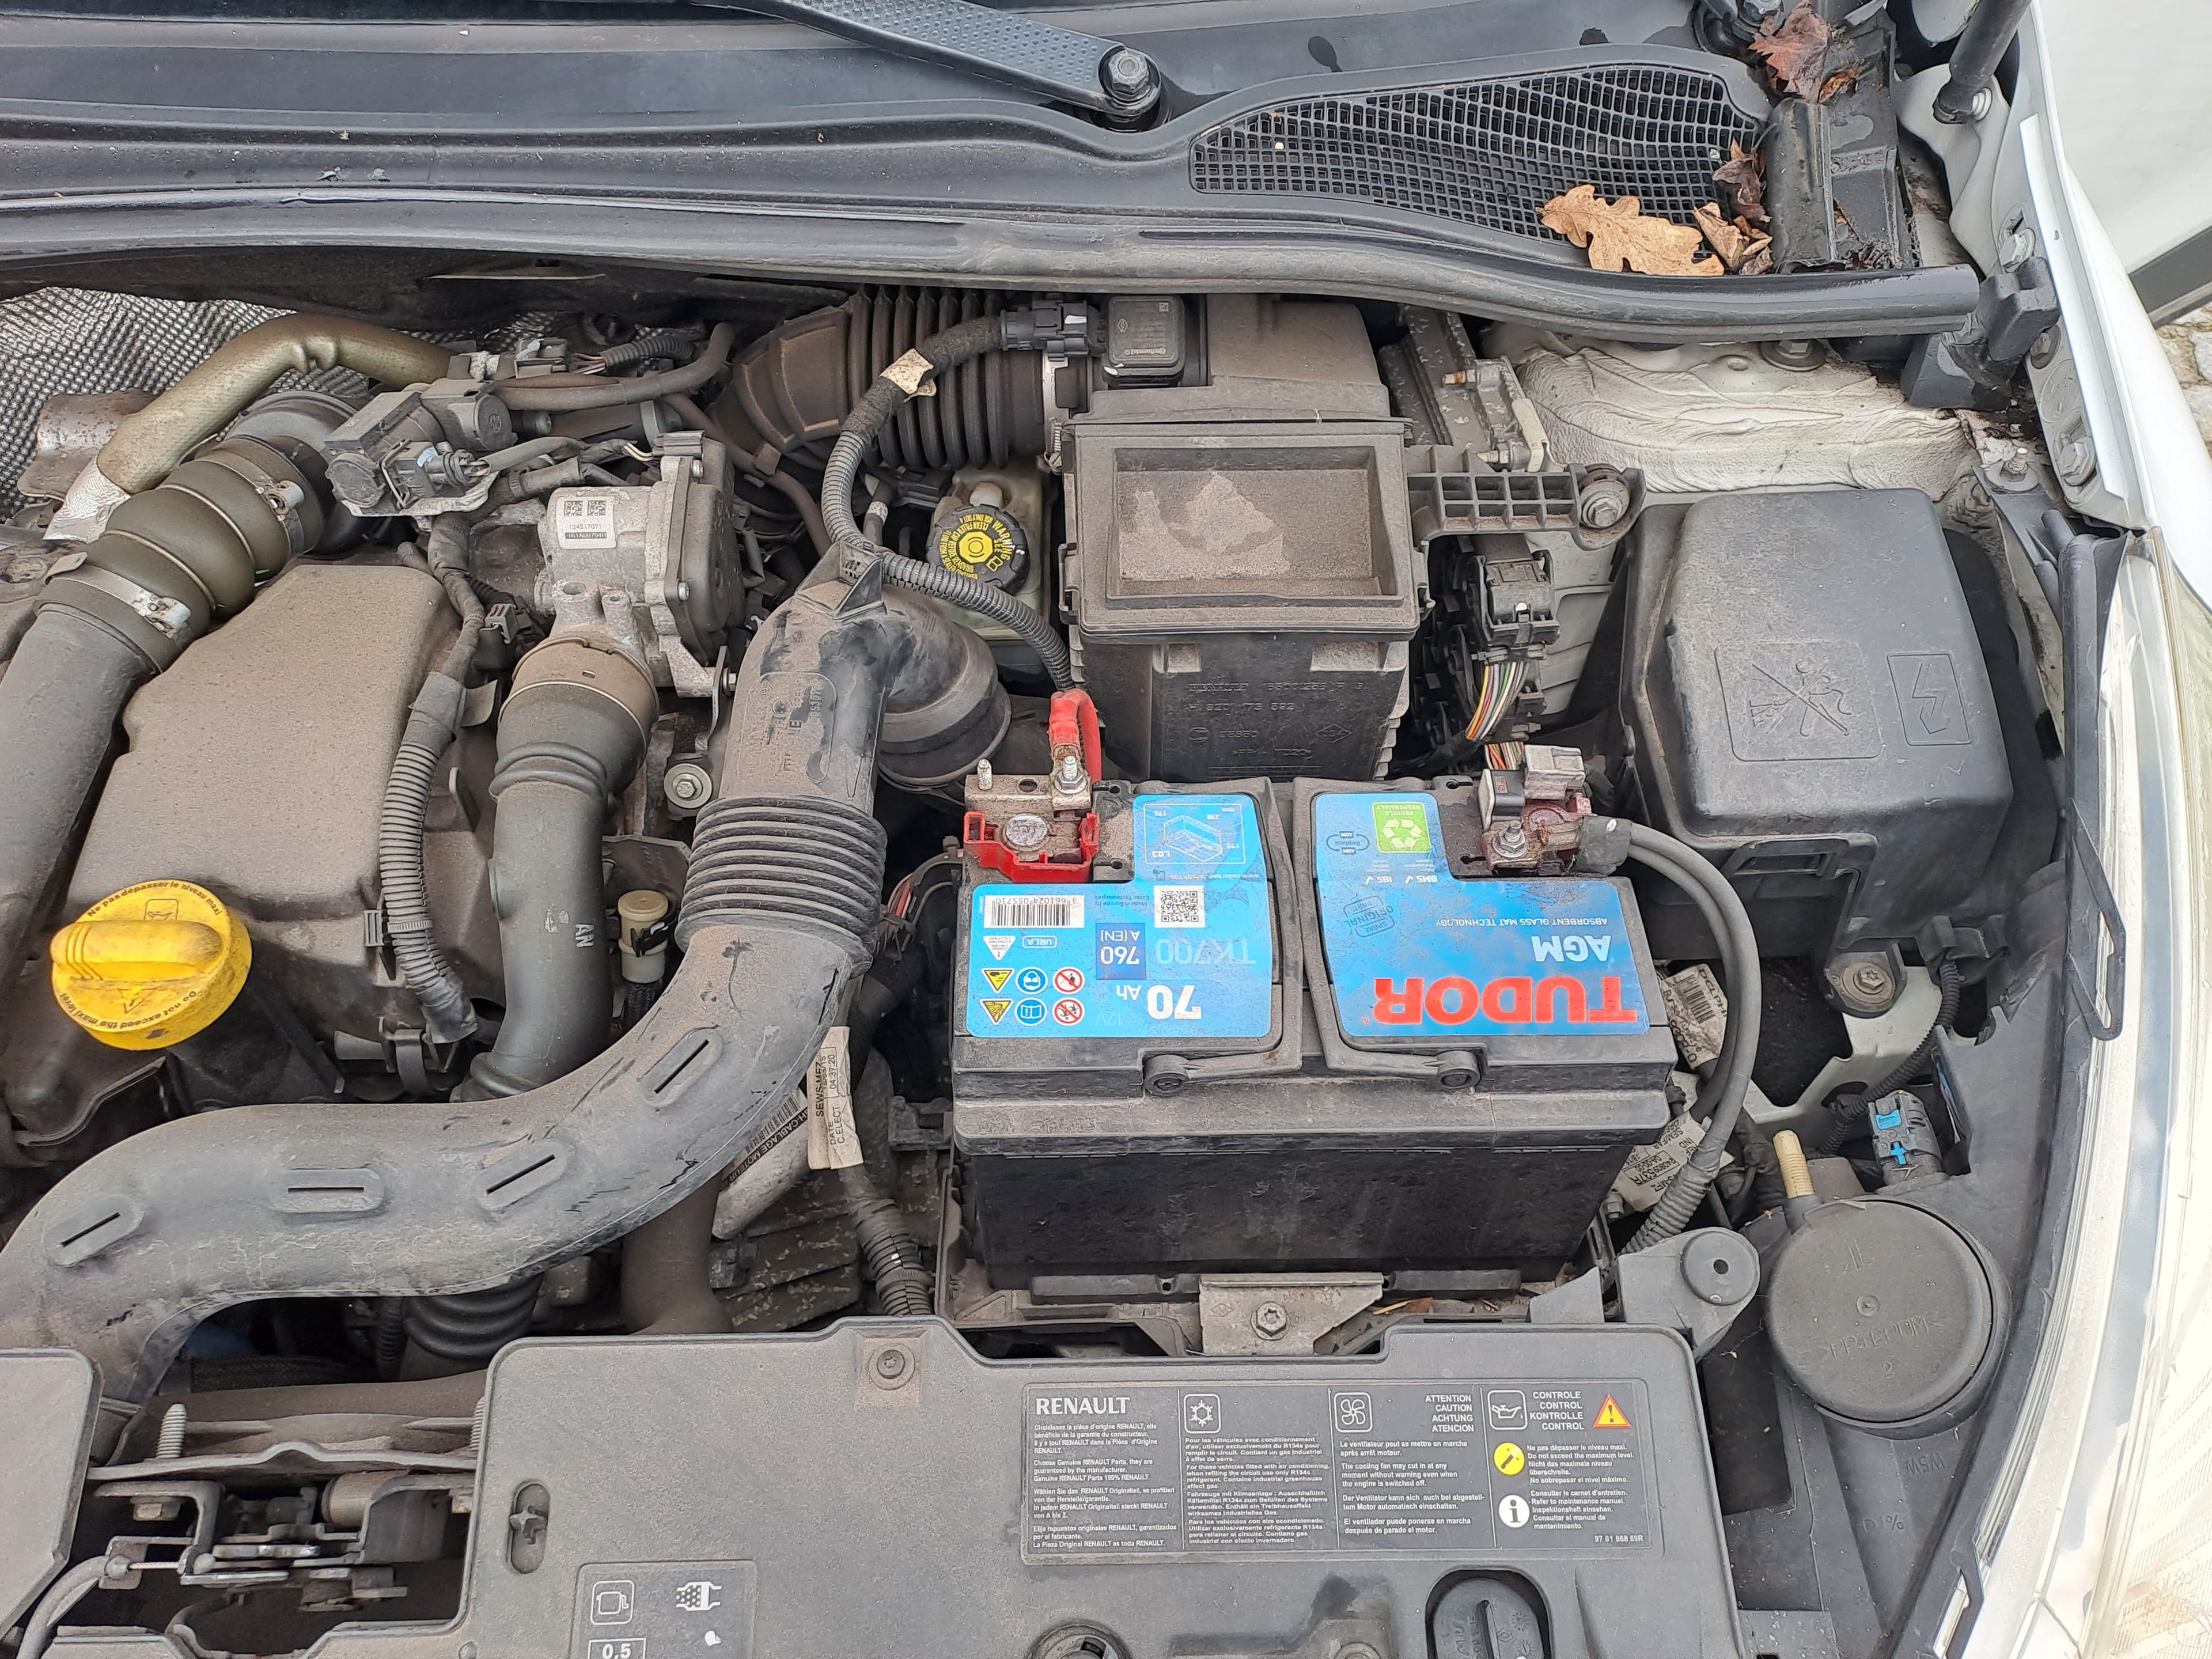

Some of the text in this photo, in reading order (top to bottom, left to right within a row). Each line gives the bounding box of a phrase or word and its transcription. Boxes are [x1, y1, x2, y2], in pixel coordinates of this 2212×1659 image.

[1416, 875, 1438, 883] BMS
[103, 895, 120, 907] pas
[121, 881, 169, 897] dépasser
[180, 884, 207, 900] niveau
[205, 898, 223, 916] maxi
[1343, 905, 1393, 927] ORIGINAL
[1435, 917, 1609, 927] ABSORBENT GLASS MAT TECHNOLOGY
[1363, 921, 1388, 934] SPARE
[1100, 929, 1141, 942] A (EN)
[1156, 938, 1257, 965] TK700
[1531, 935, 1612, 963] AGM
[1100, 945, 1140, 965] 760
[1115, 984, 1202, 1020] 70 Ah
[1372, 976, 1638, 1025] TUDOR
[59, 990, 197, 1029] Do not exceed the maxi level
[827, 1054, 837, 1090] 04:37:20
[828, 1121, 837, 1146] DATE
[1679, 1137, 1694, 1148] IND
[1425, 1394, 1471, 1403] ATTENTION
[1533, 1391, 1581, 1399] CONTROLE
[1036, 1397, 1131, 1416] RENAULT
[1435, 1404, 1472, 1412] CAUTION
[1539, 1401, 1583, 1410] CONTROL
[1431, 1414, 1474, 1422] ACHTUNG
[1529, 1412, 1584, 1421] KONTROLLE
[1432, 1424, 1474, 1433] ATENCION
[1541, 1422, 1585, 1430] CONTROL
[1550, 1444, 1580, 1452] dépasser
[1585, 1452, 1617, 1460] maximum
[1057, 1459, 1082, 1467] Genuine
[1355, 1463, 1379, 1471] cooling
[1395, 1471, 1422, 1479] warning
[1354, 1480, 1376, 1488] engine
